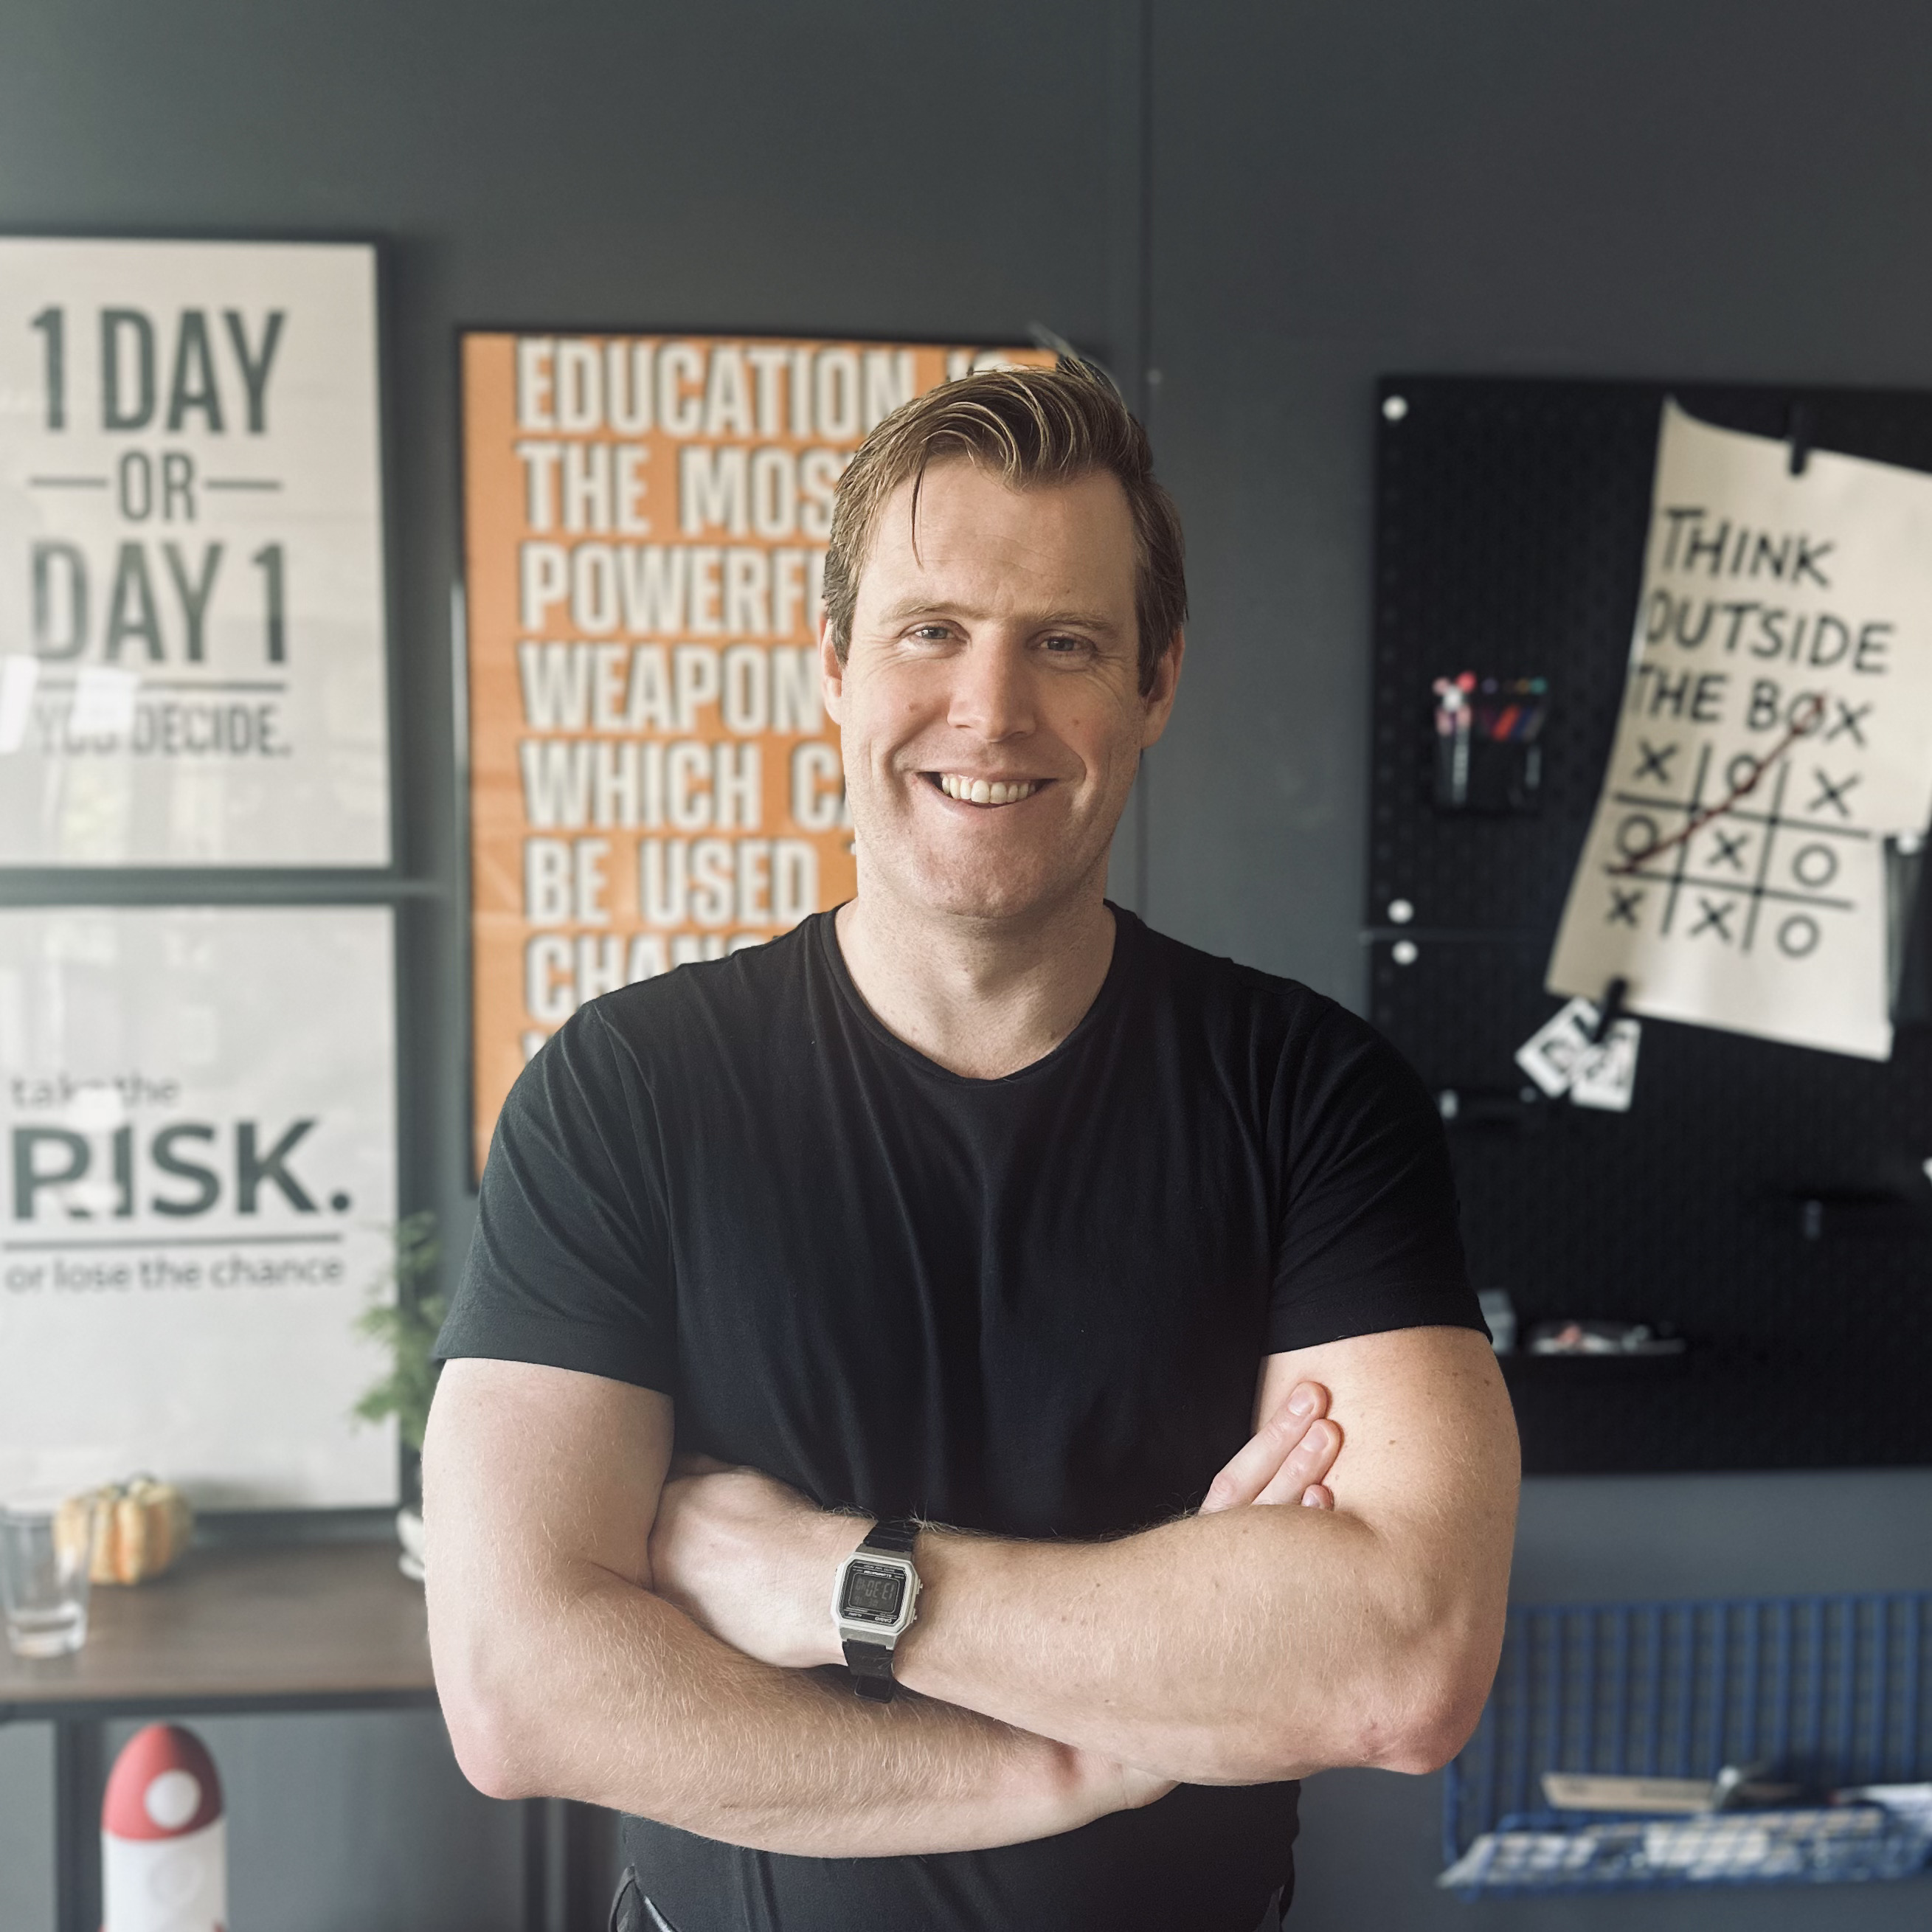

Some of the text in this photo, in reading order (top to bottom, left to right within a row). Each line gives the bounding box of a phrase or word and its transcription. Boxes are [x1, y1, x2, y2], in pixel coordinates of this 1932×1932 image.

[30, 305, 286, 434] 1 DAY
[516, 337, 917, 441] EDUCATION
[118, 451, 197, 522] OR
[516, 442, 854, 540] THE MOS
[1663, 508, 1835, 589] THINK
[32, 541, 287, 665] DAY 1
[1646, 590, 1894, 674] OUTSIDE
[131, 701, 292, 756] DECIDE.
[518, 641, 822, 731] WEAPON
[1627, 663, 1874, 749] THE BOX
[520, 740, 854, 831] WHICH C
[524, 838, 820, 926] BE USED
[524, 932, 772, 1025] CHA
[12, 1118, 352, 1222] RISK.
[5, 1253, 344, 1294] or lose the chance
